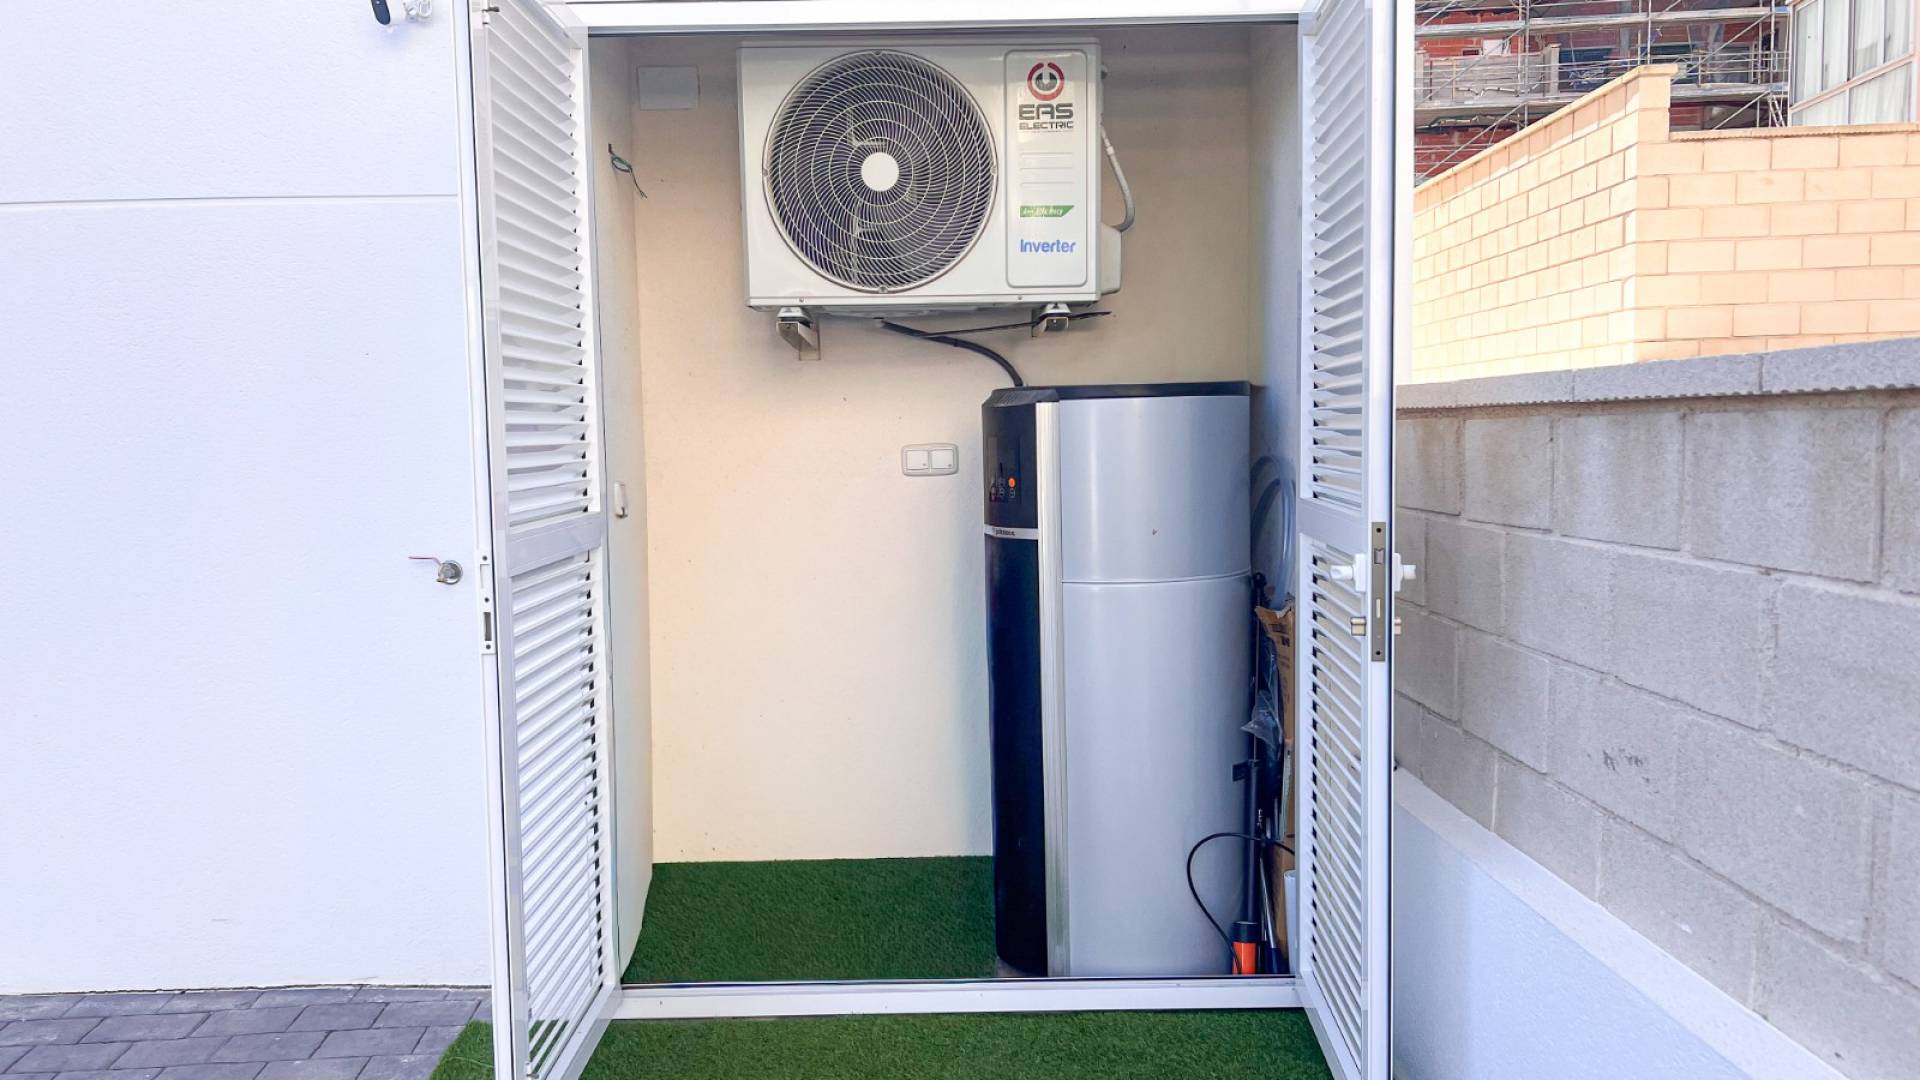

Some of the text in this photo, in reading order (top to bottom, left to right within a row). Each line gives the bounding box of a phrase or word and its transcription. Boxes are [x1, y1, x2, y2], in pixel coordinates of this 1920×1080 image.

[1019, 103, 1073, 120] EAS
[1019, 121, 1074, 130] ELECTRIC
[1020, 240, 1076, 253] Inverter
